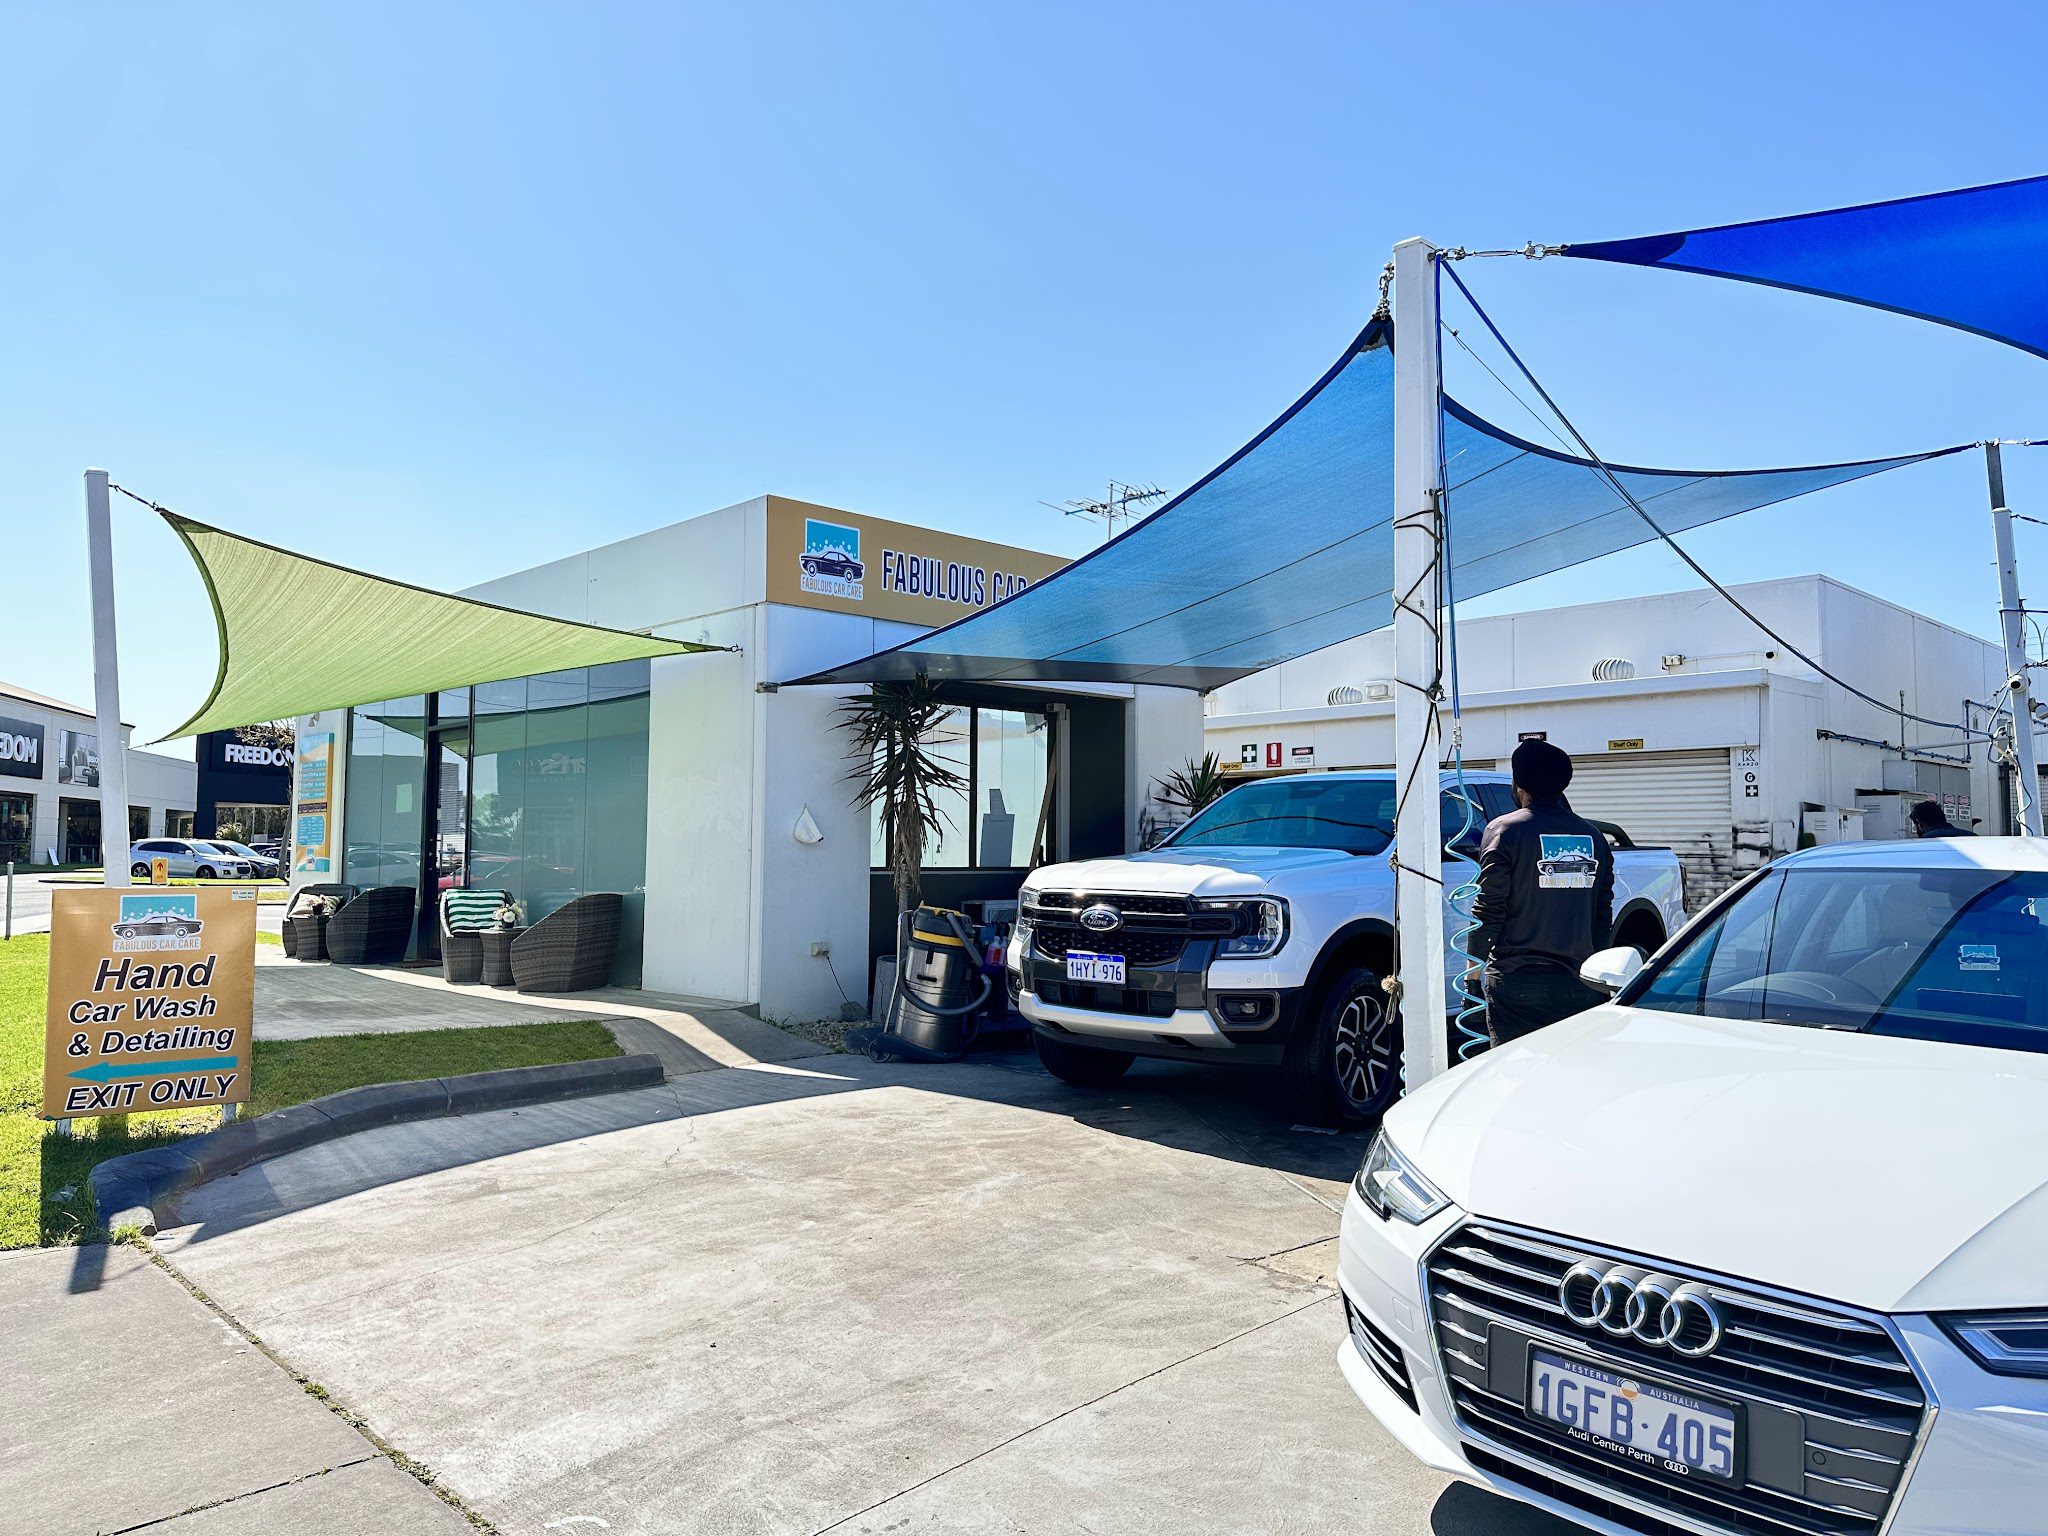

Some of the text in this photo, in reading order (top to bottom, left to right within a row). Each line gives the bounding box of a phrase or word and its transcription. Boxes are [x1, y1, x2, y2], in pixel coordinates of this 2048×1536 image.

[802, 577, 862, 599] FABULOUS CAR CARE
[881, 549, 985, 607] FABULOUS
[114, 938, 199, 951] FABULOUS CAR CARE
[93, 955, 217, 993] Hand
[68, 993, 217, 1024] Car Wash
[66, 1025, 236, 1058] & Detailing
[65, 1074, 237, 1112] EXIT ONLY
[1564, 1361, 1700, 1411] WESTERN AUSTRALIA
[1567, 1426, 1655, 1465] Audi Centre Perth
